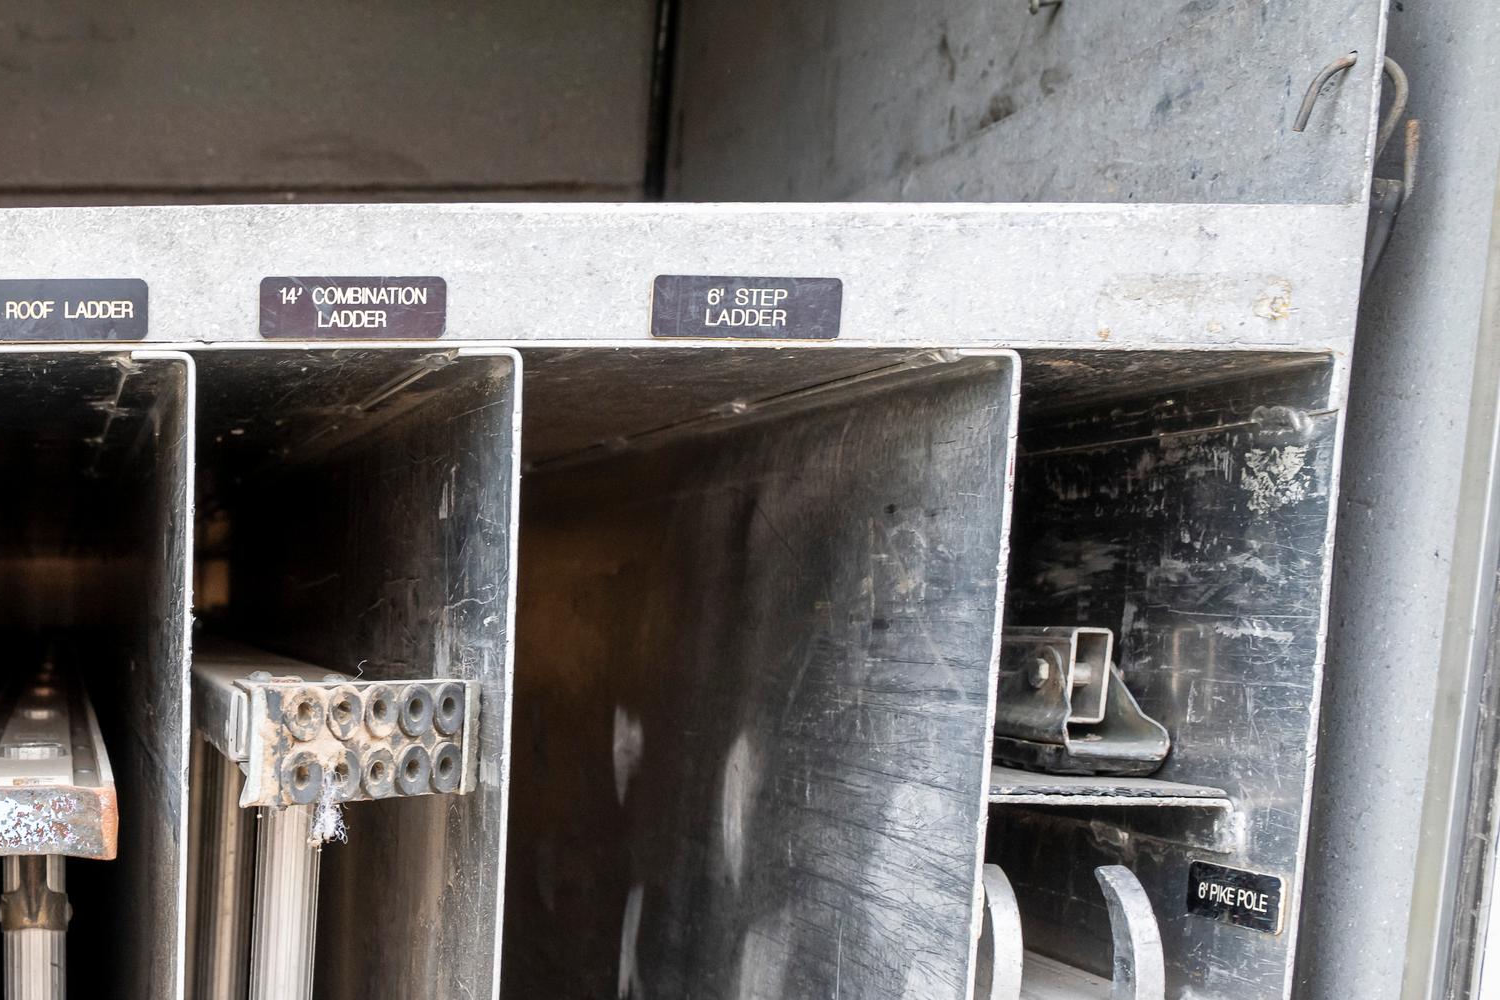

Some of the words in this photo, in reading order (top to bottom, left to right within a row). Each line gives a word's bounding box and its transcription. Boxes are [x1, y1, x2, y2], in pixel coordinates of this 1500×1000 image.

[278, 288, 303, 306] 14'
[311, 288, 428, 307] COMBINATION
[707, 289, 725, 307] 6'
[734, 289, 788, 307] STEP
[5, 300, 54, 320] ROOF
[63, 300, 134, 320] LADDER
[317, 310, 387, 329] LADDER
[705, 309, 787, 327] LADDER
[1198, 883, 1209, 899] 6'
[1209, 884, 1235, 907] PIKE
[1237, 889, 1269, 913] POLE
